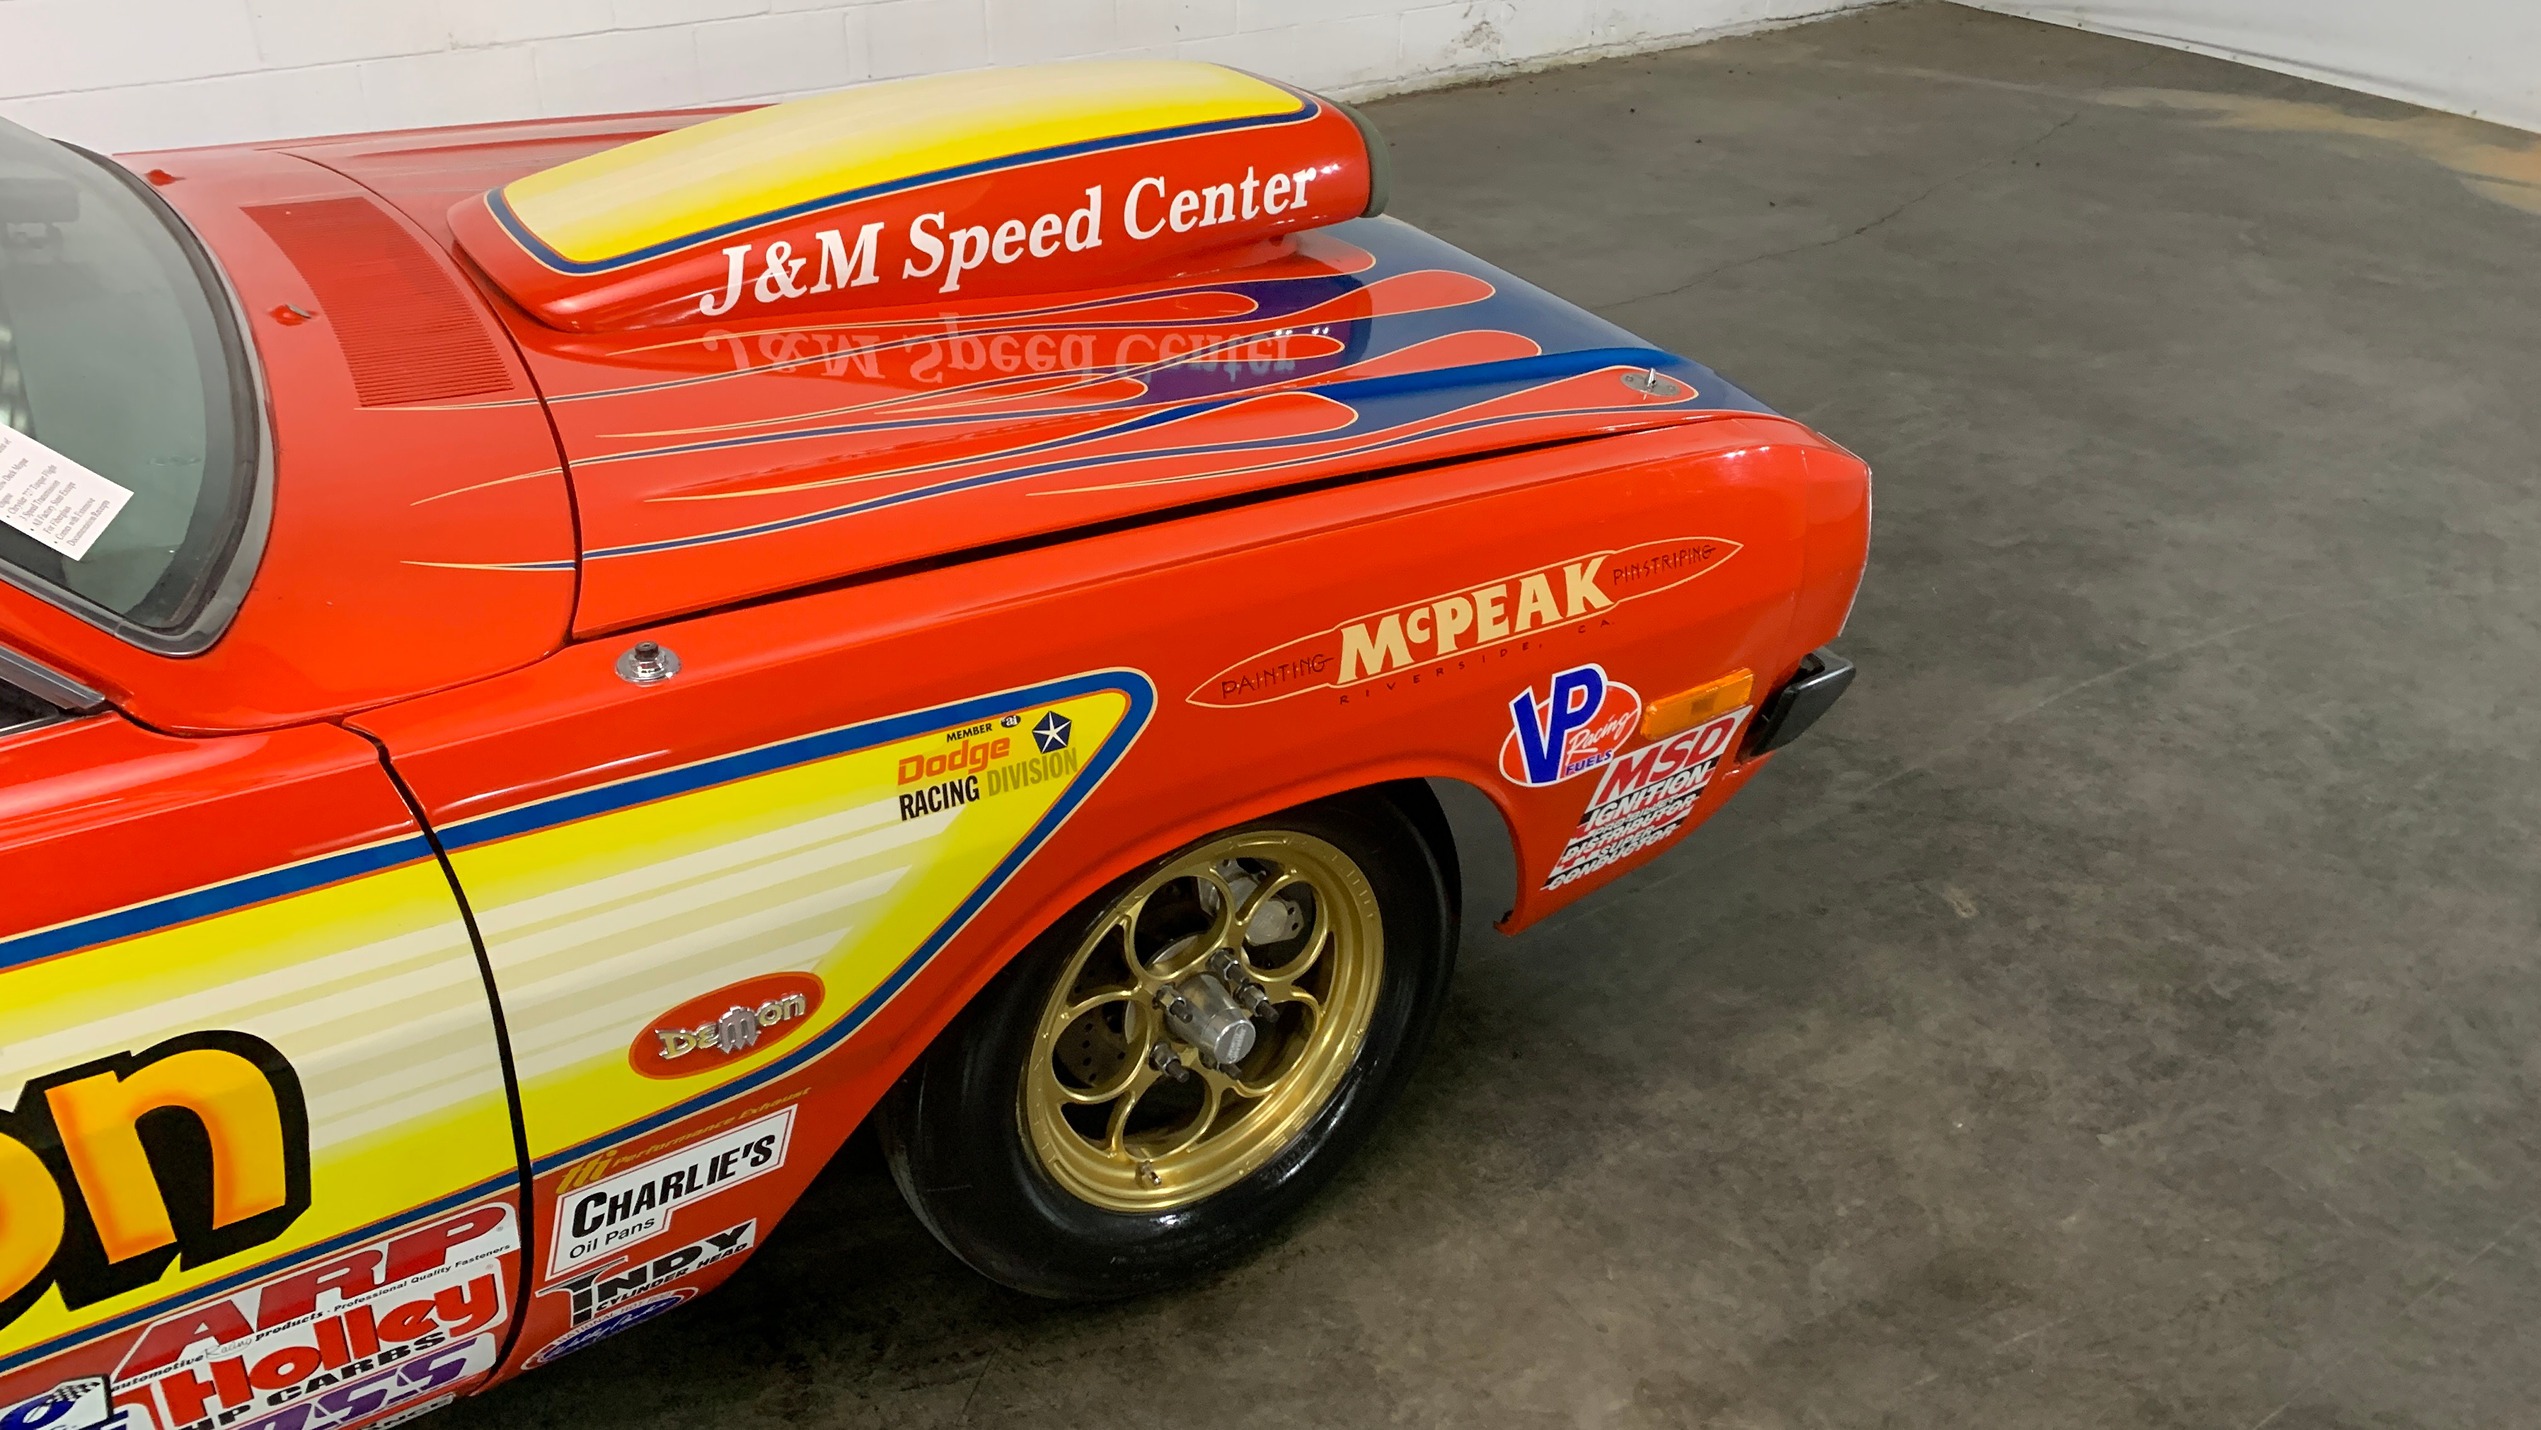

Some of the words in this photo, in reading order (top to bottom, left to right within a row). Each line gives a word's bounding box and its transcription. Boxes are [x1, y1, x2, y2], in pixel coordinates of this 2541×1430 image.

[700, 222, 884, 316] J&M
[902, 186, 1104, 295] Speed
[1123, 166, 1319, 241] Center
[1221, 653, 1334, 699] PAINTING
[1613, 544, 1717, 586] PINSTRIPING
[898, 737, 1011, 786] Dodge
[946, 722, 993, 743] MEMBER
[1512, 667, 1604, 784] VP
[1565, 750, 1613, 776] FUELS
[1567, 713, 1632, 764] Racing
[1594, 717, 1736, 806] MSD
[899, 775, 981, 821] RACING
[987, 747, 1078, 797] DIVISION
[1584, 762, 1709, 833] IGNITION
[1561, 793, 1698, 864] DISTRIBUTOR
[612, 1116, 735, 1168] Performance
[572, 1134, 776, 1239] CHARLIE'S
[537, 1220, 754, 1328] INDY
[569, 1238, 599, 1260] Oil
[605, 1217, 656, 1246] Pans
[113, 1206, 507, 1384] ARP
[595, 1267, 690, 1311] CYLINDER
[697, 1242, 748, 1270] HEAD
[111, 1354, 205, 1392] automotive
[254, 1309, 325, 1342] products
[333, 1281, 408, 1312] Professional
[411, 1264, 451, 1285] Quality
[455, 1243, 511, 1268] Fasteners
[160, 1273, 499, 1428] Holley
[266, 1331, 446, 1407] CARBS
